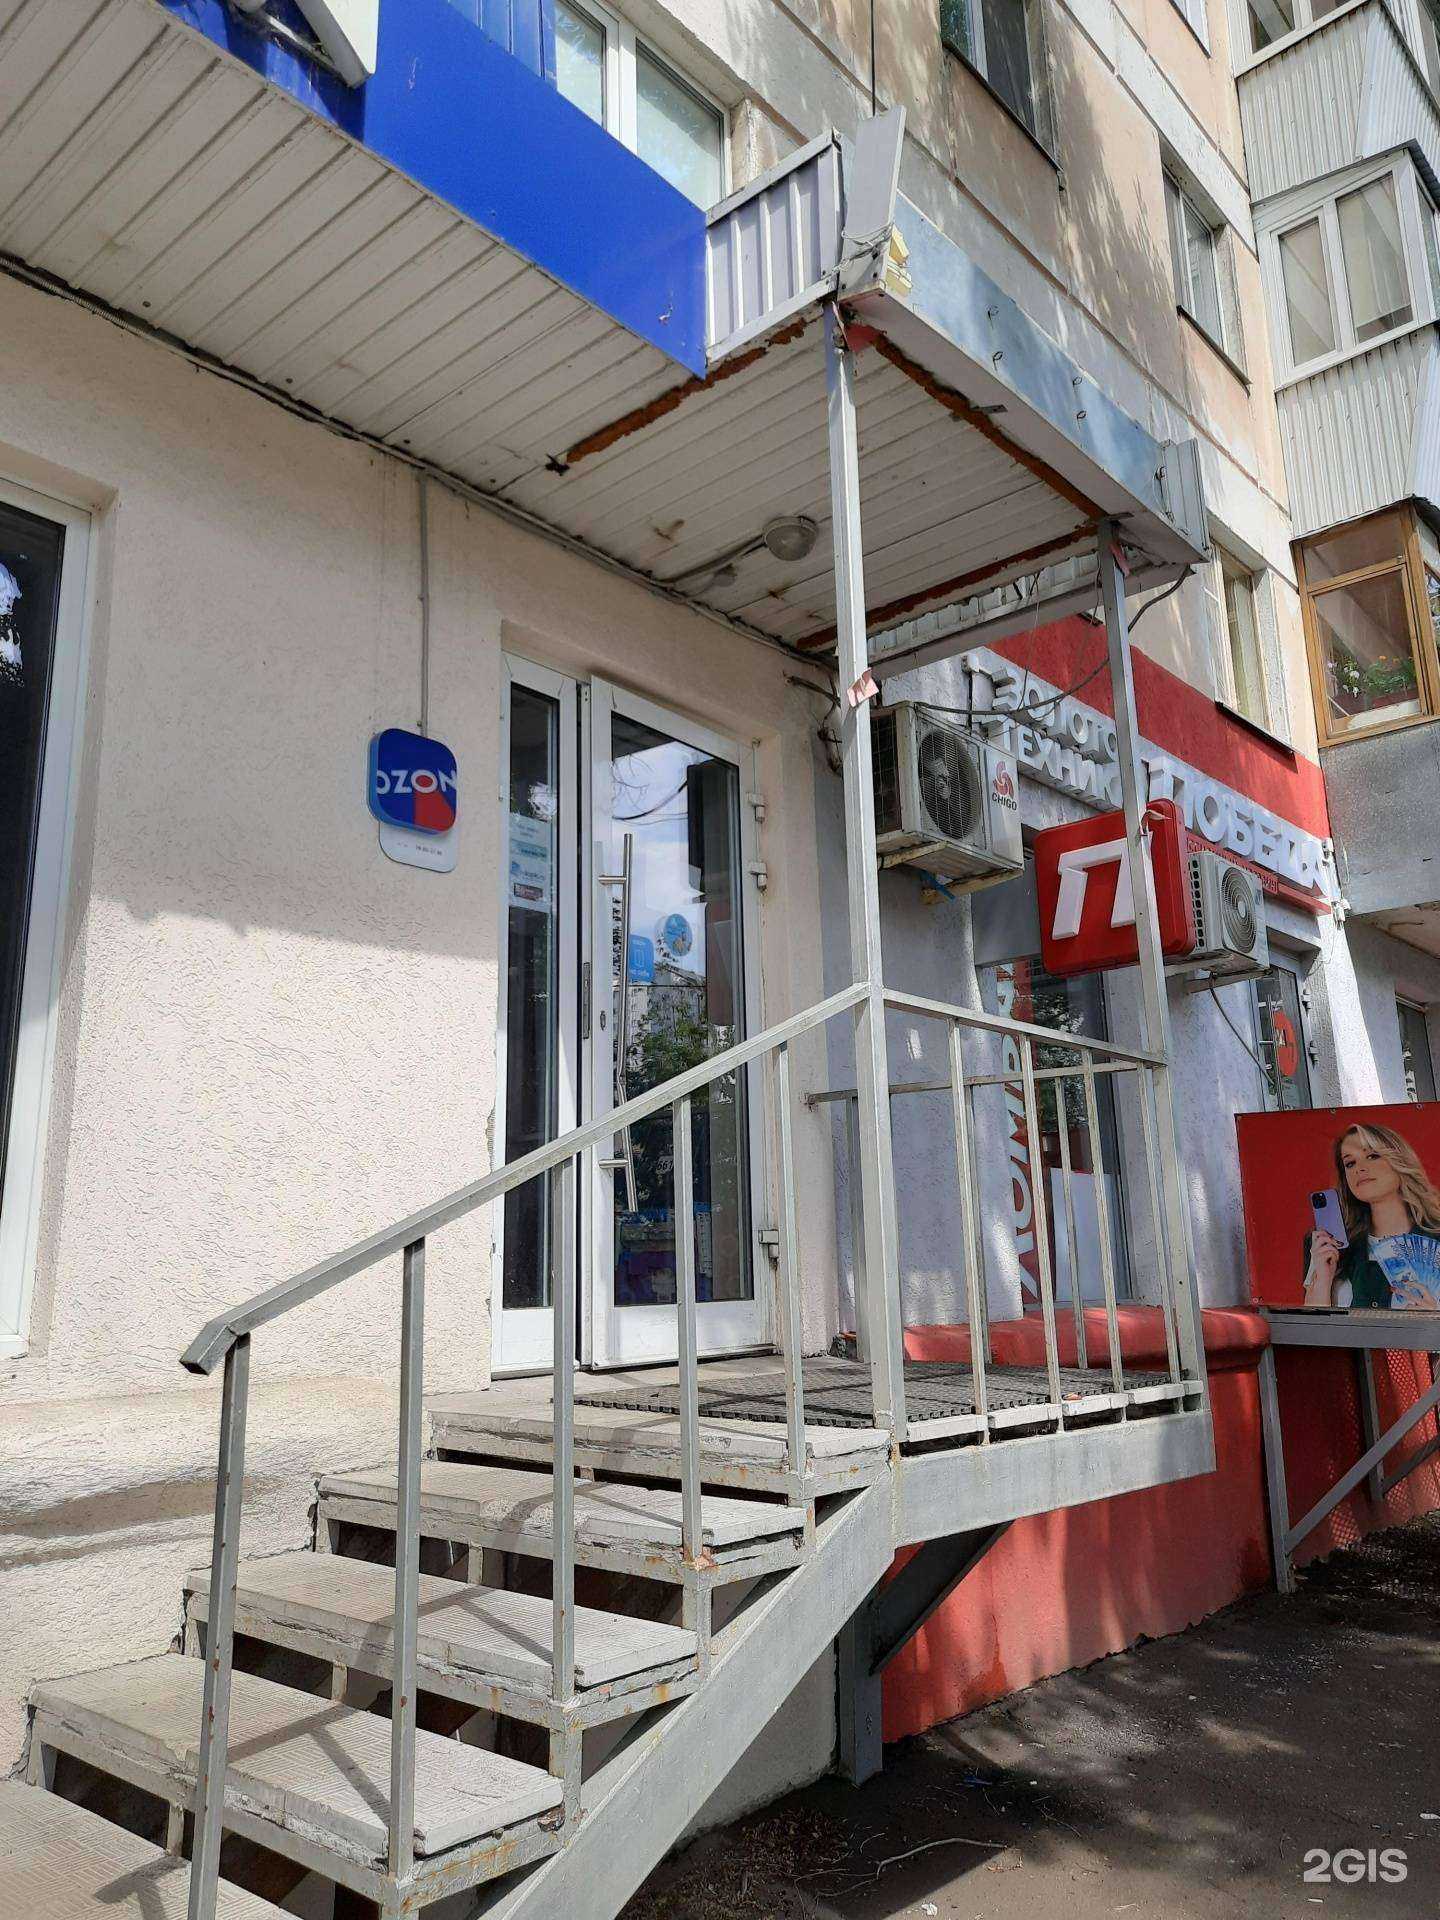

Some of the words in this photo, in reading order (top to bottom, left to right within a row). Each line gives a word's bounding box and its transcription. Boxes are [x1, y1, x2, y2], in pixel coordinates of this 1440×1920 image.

[376, 768, 457, 795] OZON
[985, 714, 1123, 810] ТЕХНИК
[992, 792, 1017, 811] CHIGO
[1146, 756, 1335, 898] ПОБЕДА
